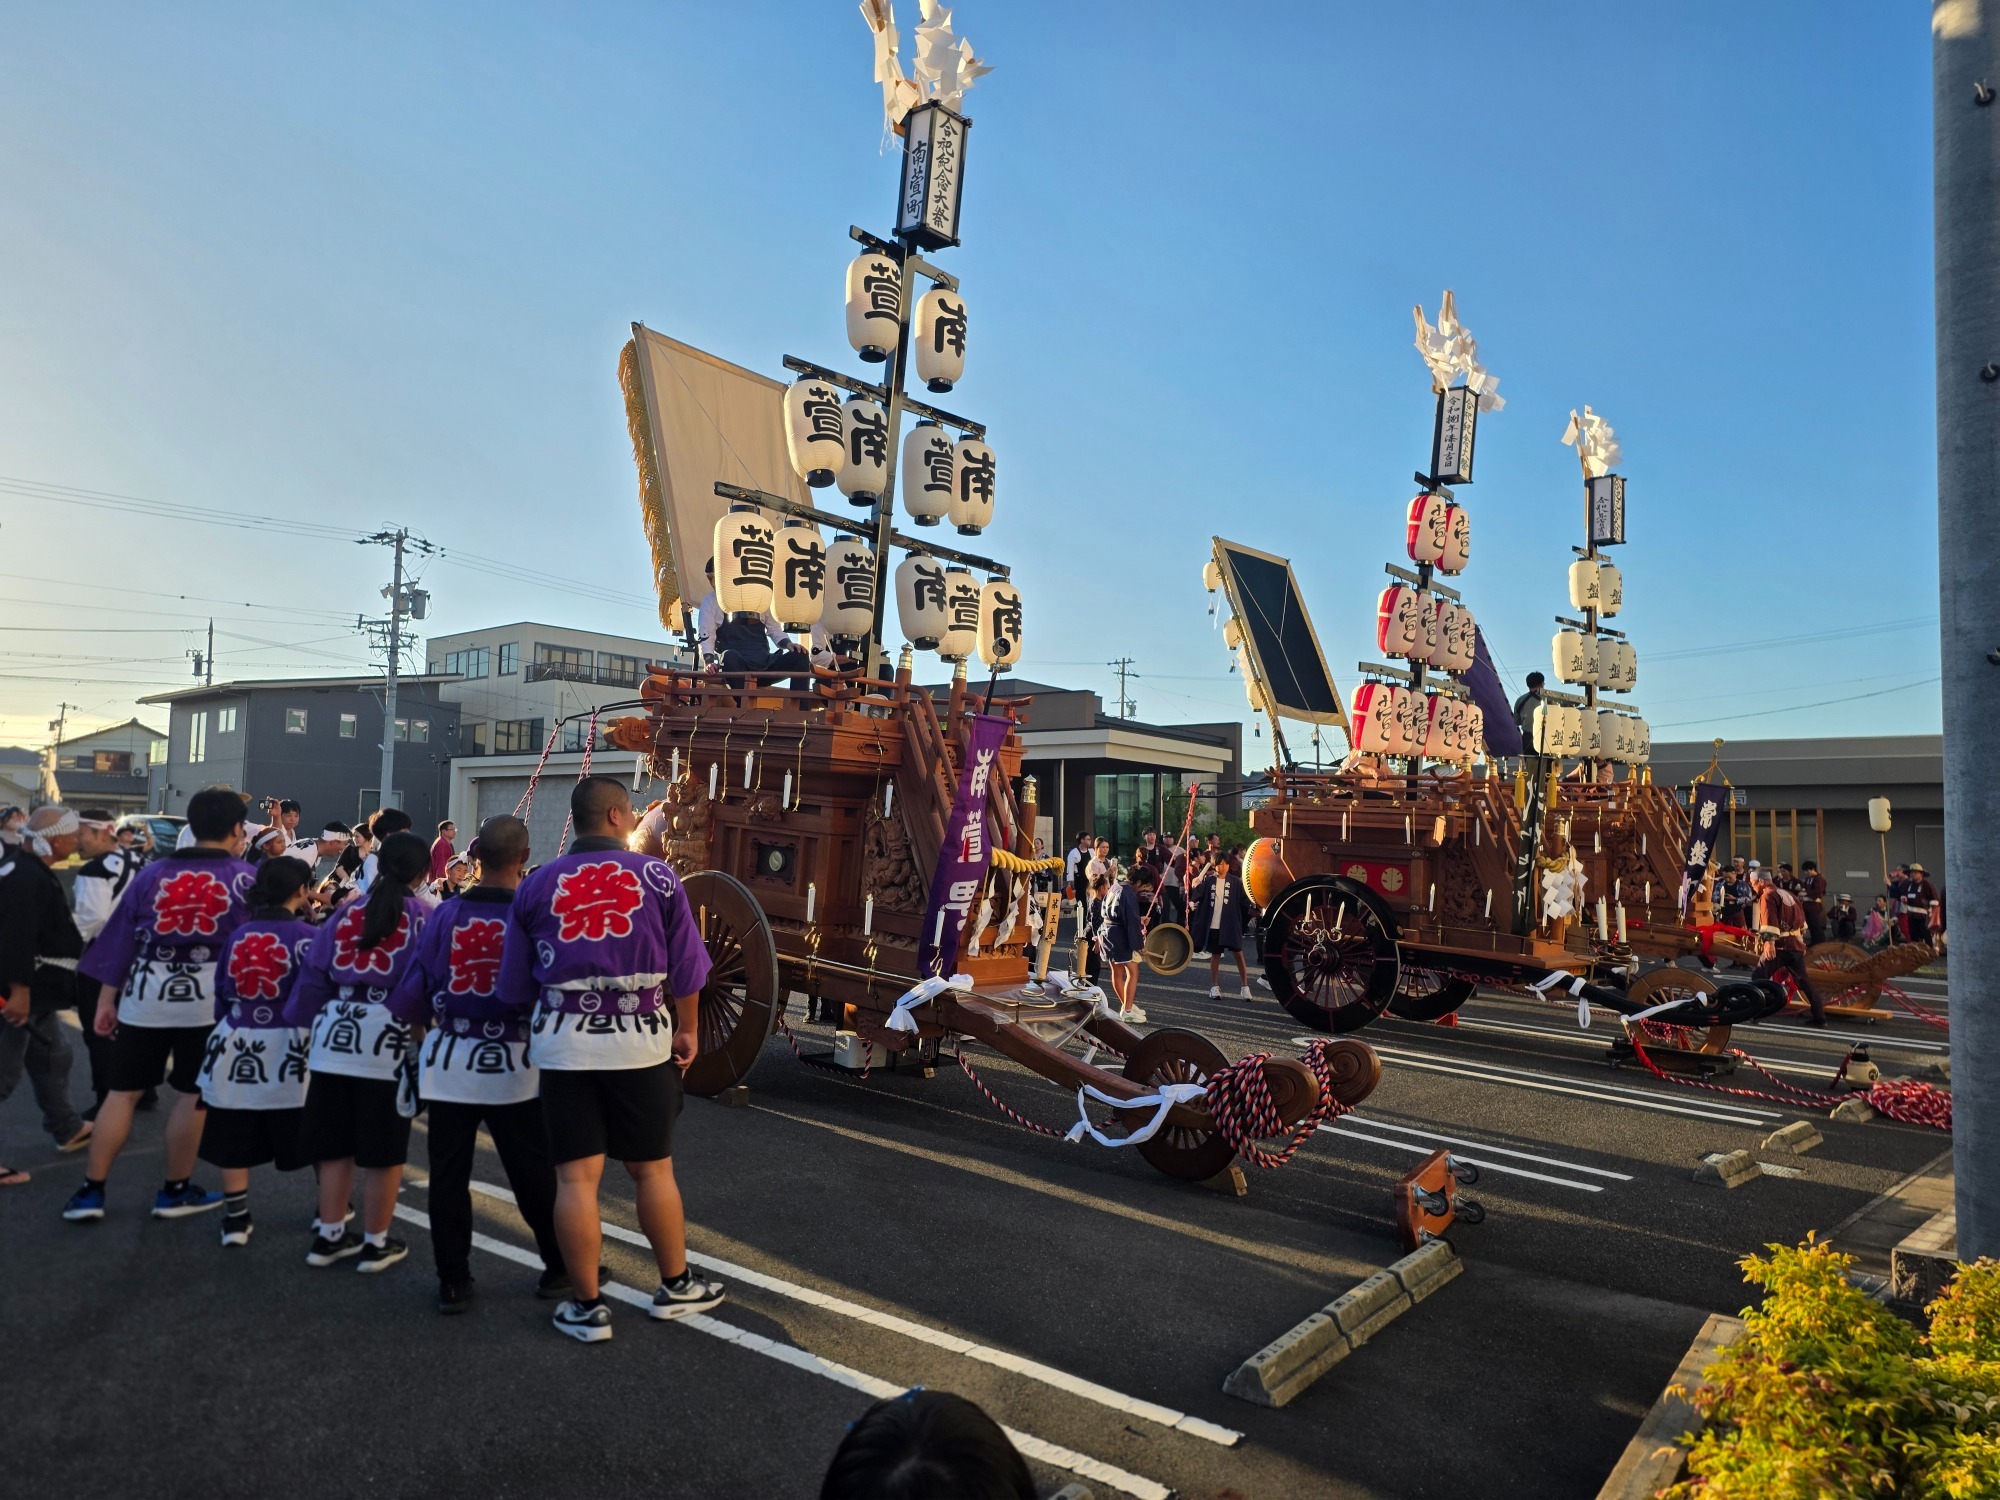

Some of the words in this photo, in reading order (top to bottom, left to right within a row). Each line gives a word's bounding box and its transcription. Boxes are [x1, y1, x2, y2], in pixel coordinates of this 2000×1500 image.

[154, 870, 232, 936] 祭
[551, 860, 646, 943] 祭
[228, 931, 291, 1000] 祭
[449, 917, 506, 996] 祭
[1286, 1325, 1309, 1340] CAR
